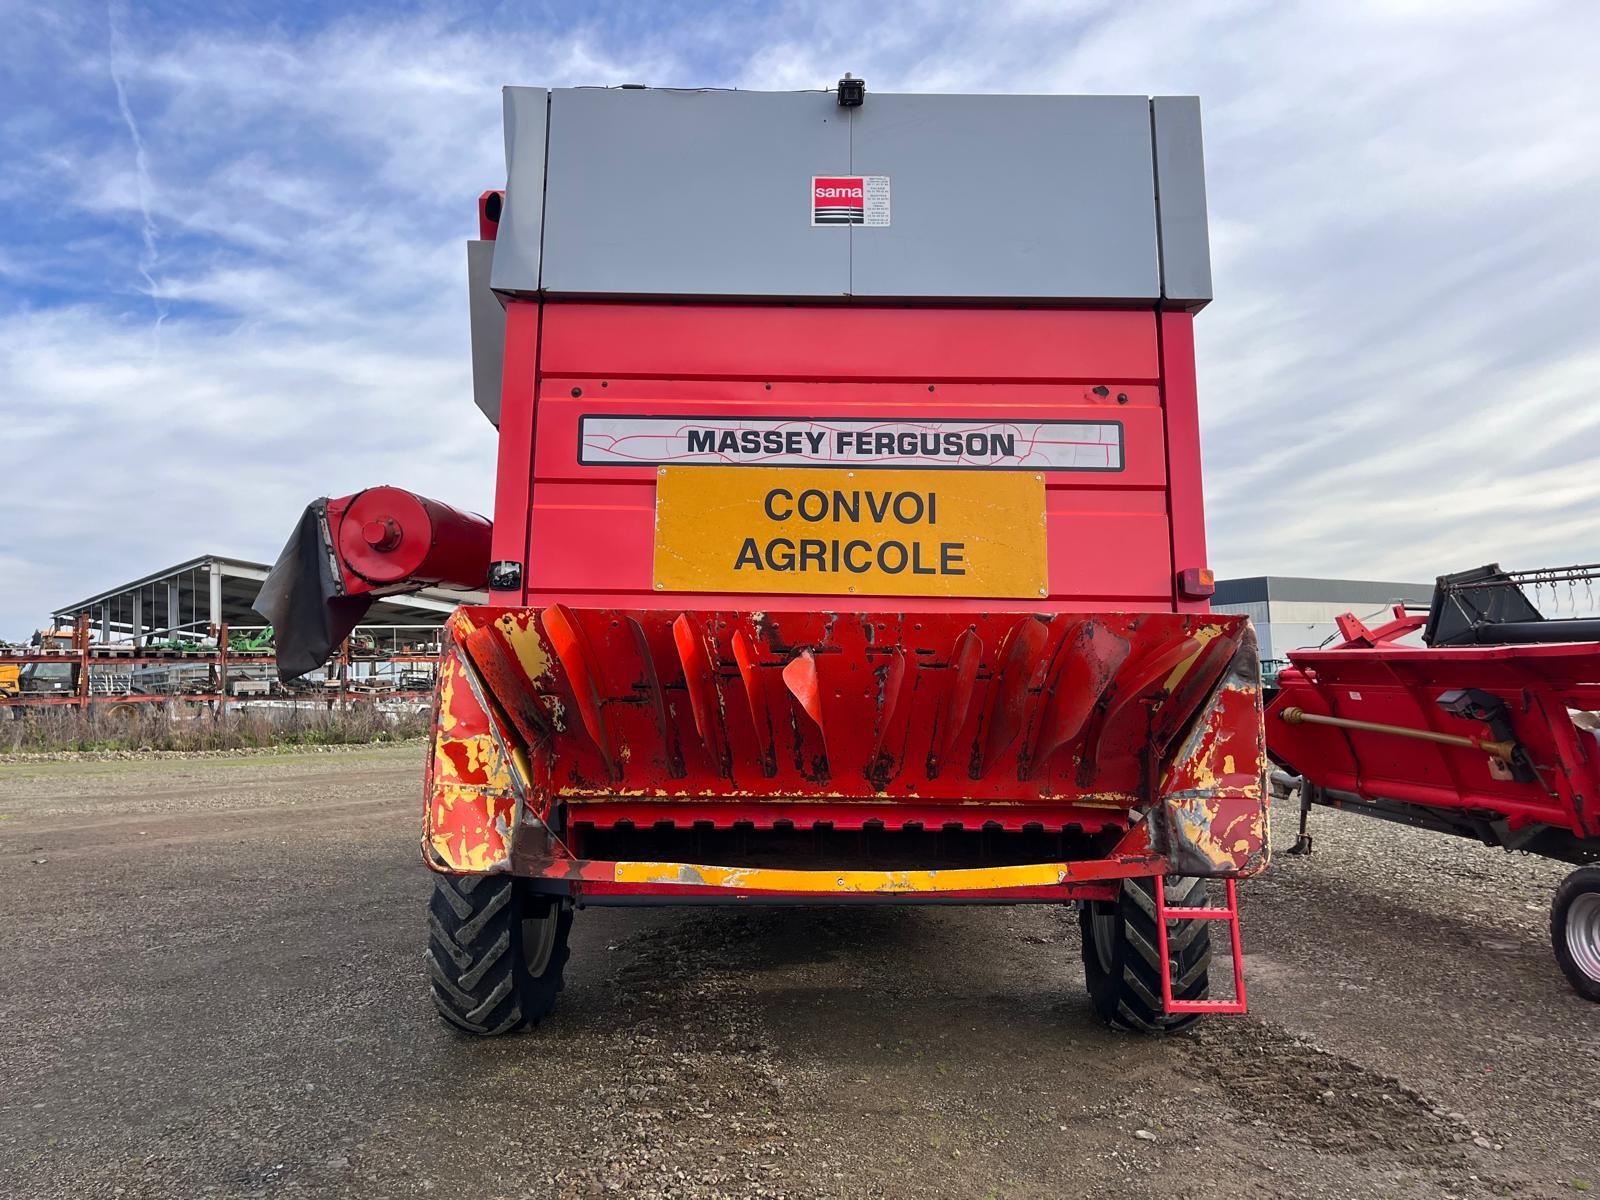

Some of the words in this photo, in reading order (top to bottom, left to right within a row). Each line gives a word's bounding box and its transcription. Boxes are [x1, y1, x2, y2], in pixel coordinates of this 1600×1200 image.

[815, 187, 863, 198] sama
[687, 430, 826, 455] MASSEY
[836, 431, 1016, 457] FERGUSON
[764, 488, 937, 525] CONVOI
[734, 537, 966, 576] AGRICOLE
